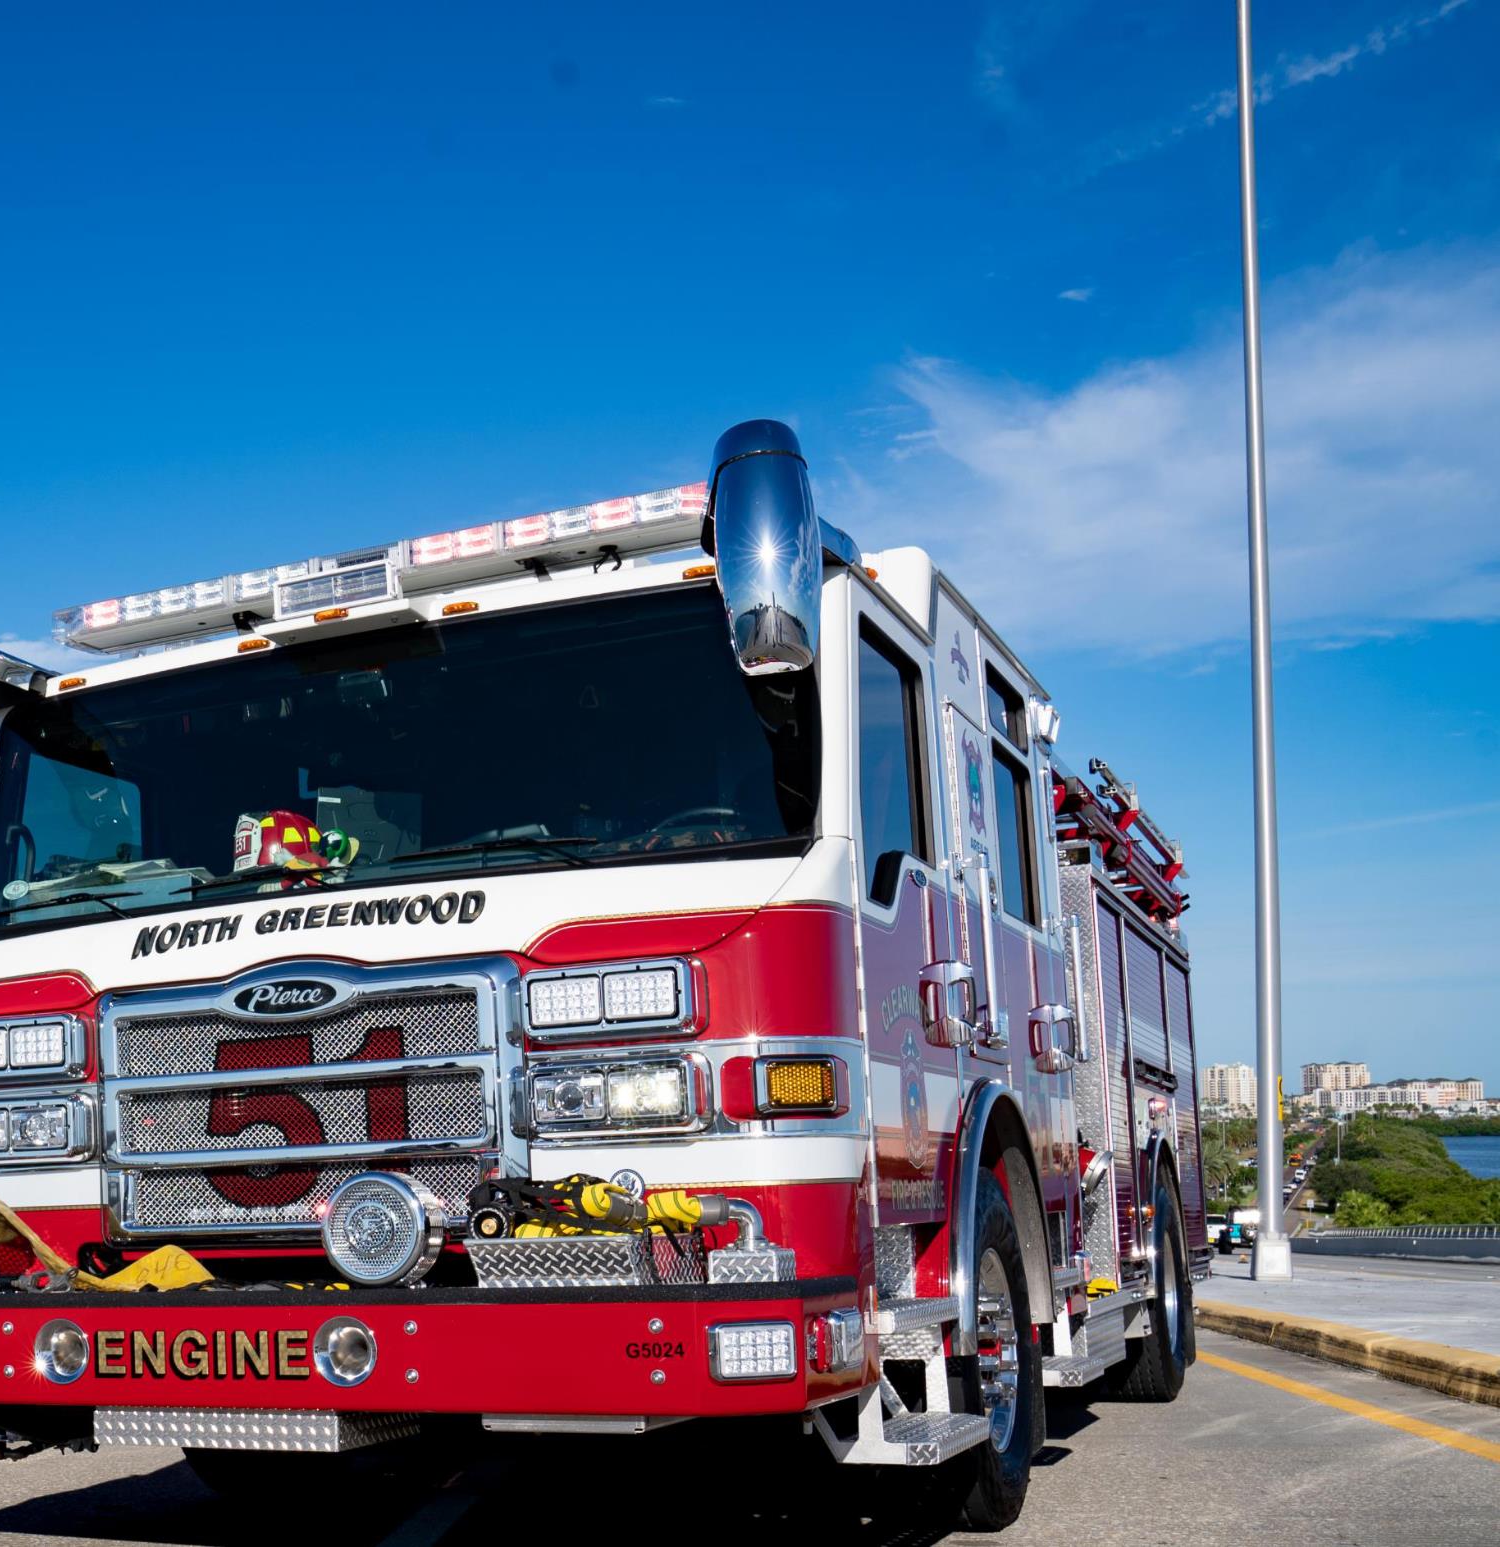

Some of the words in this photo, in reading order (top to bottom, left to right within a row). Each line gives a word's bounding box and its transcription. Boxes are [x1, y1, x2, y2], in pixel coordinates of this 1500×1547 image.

[131, 914, 243, 960] NORTH
[255, 890, 486, 935] GREENWOOD
[247, 985, 324, 1012] Pierce
[202, 1026, 408, 1208] 51
[95, 1329, 311, 1379] ENGINE
[626, 1342, 685, 1359] G5024
